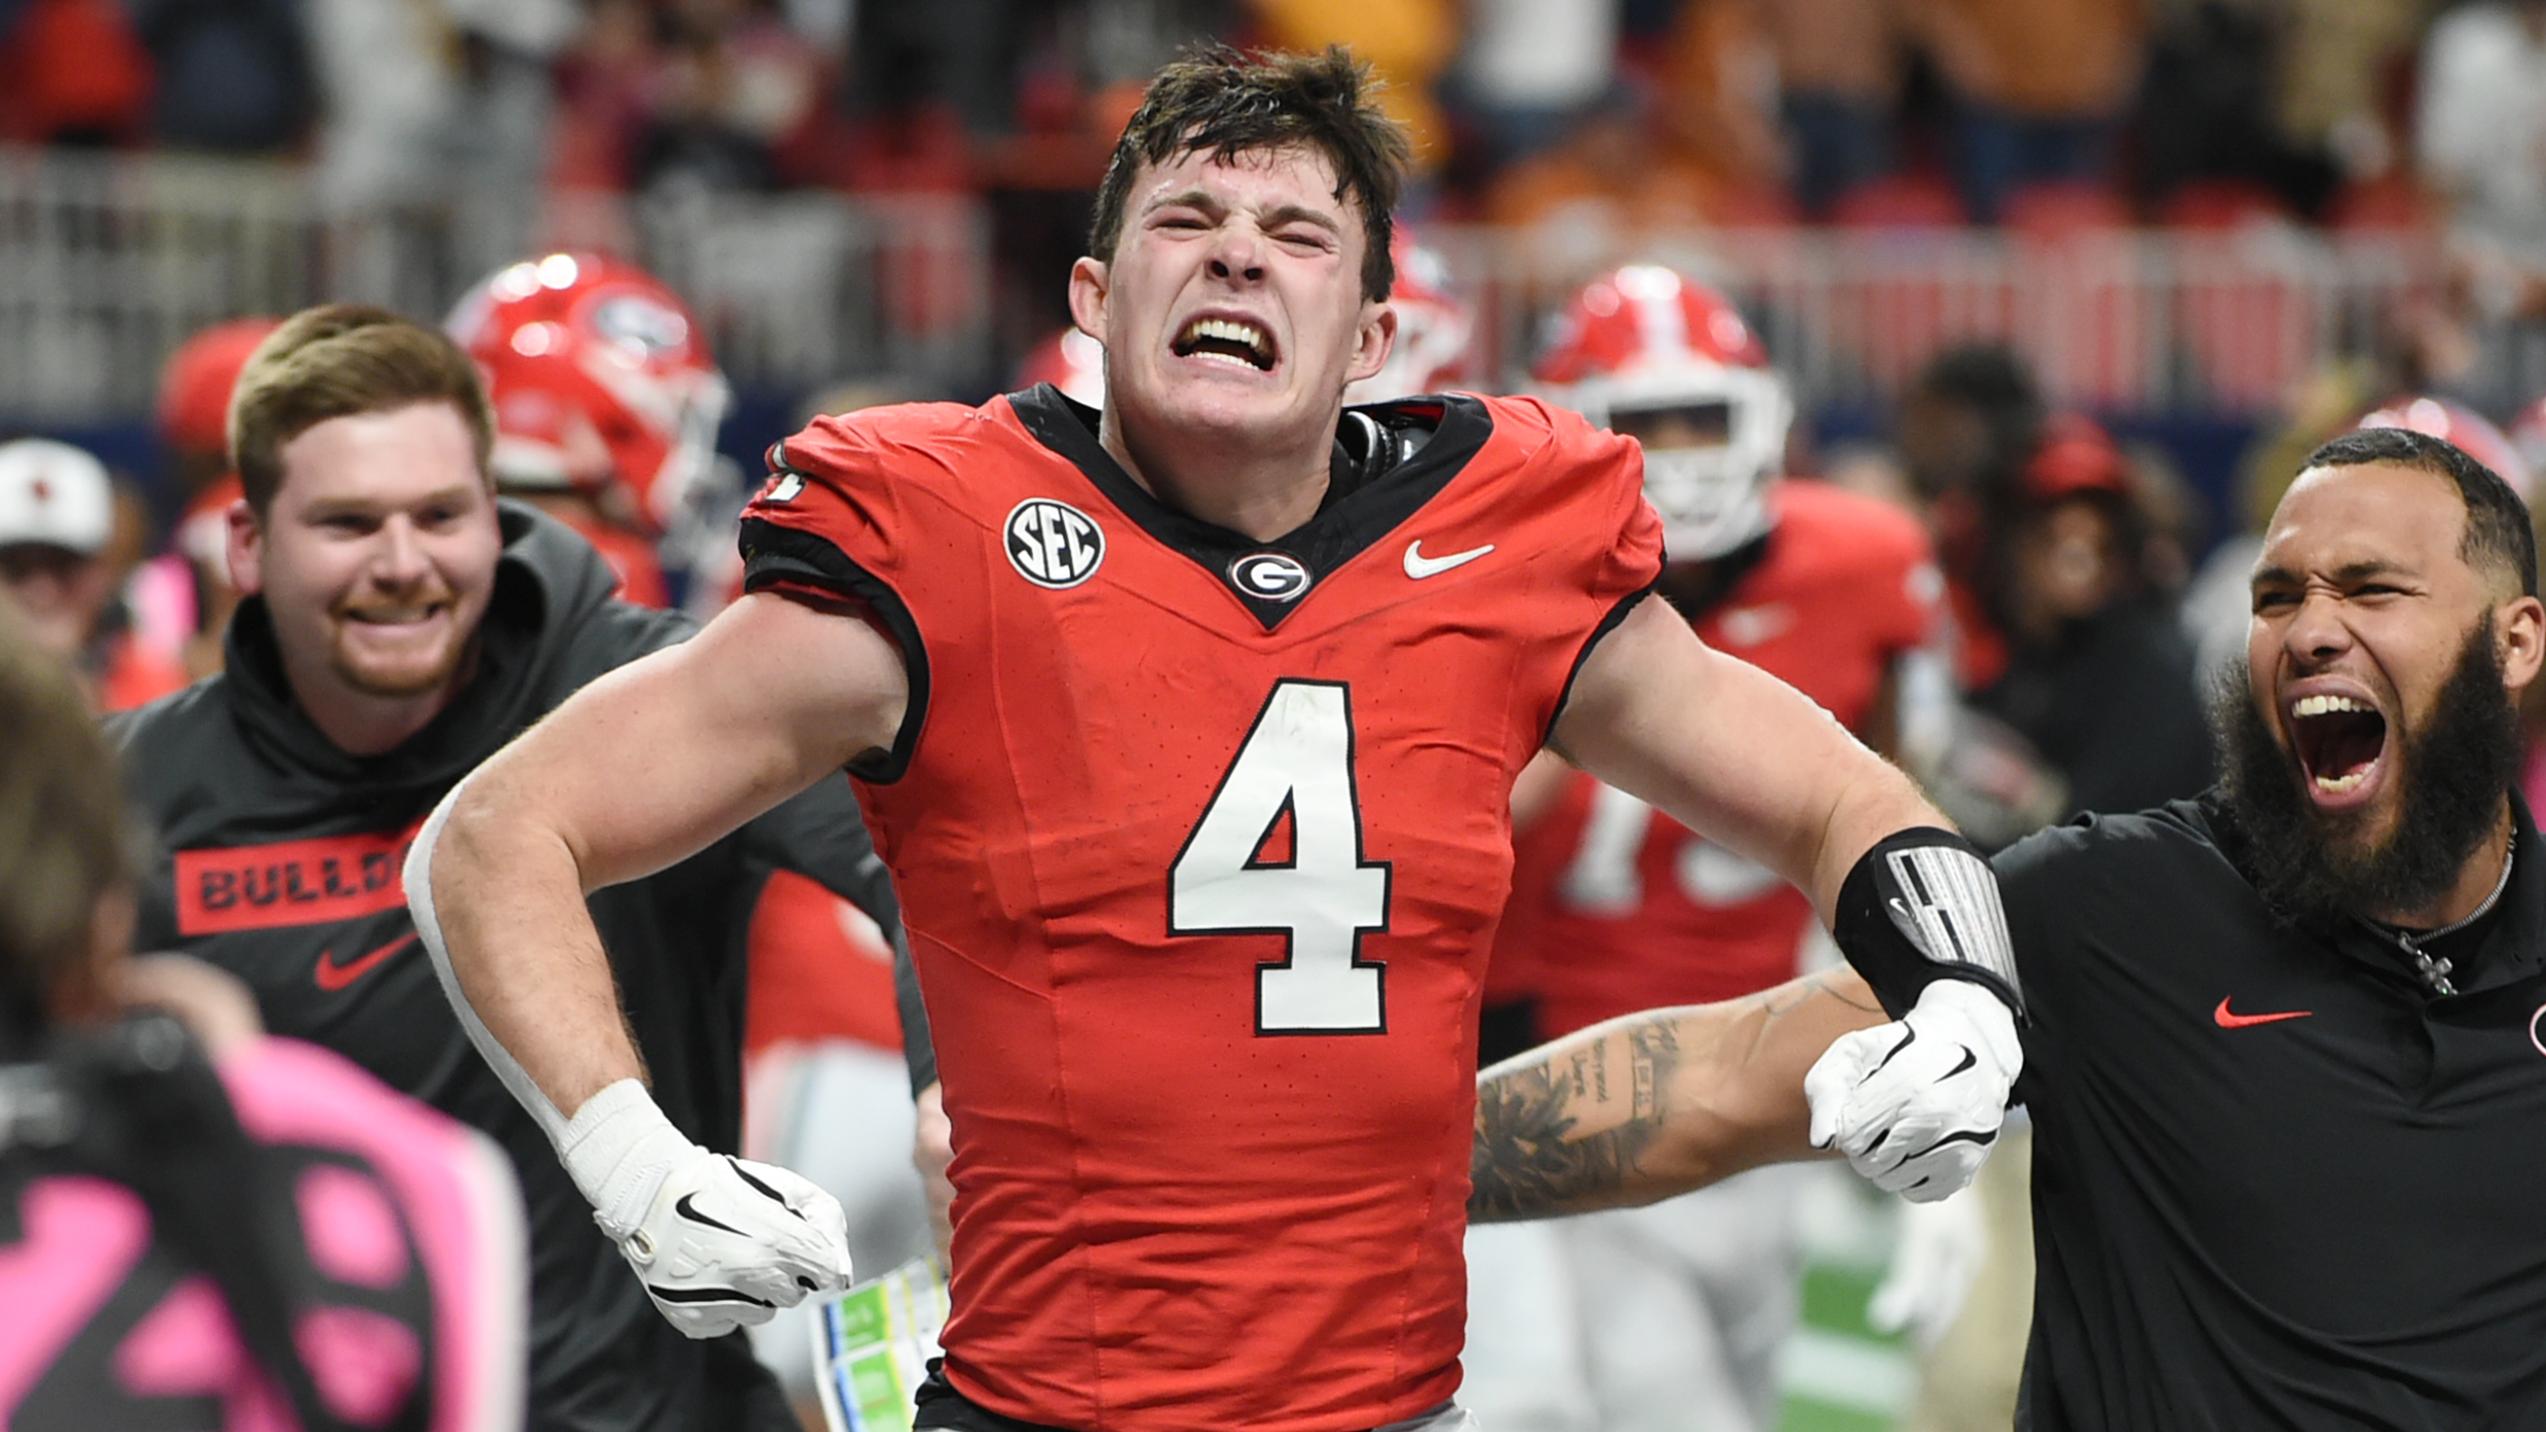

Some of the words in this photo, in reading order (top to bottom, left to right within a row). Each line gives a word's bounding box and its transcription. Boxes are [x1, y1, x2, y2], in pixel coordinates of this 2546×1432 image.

[1012, 503, 1096, 580] SEC
[1249, 560, 1305, 591] G
[202, 846, 408, 911] BULLD
[1168, 677, 1392, 1036] 4
